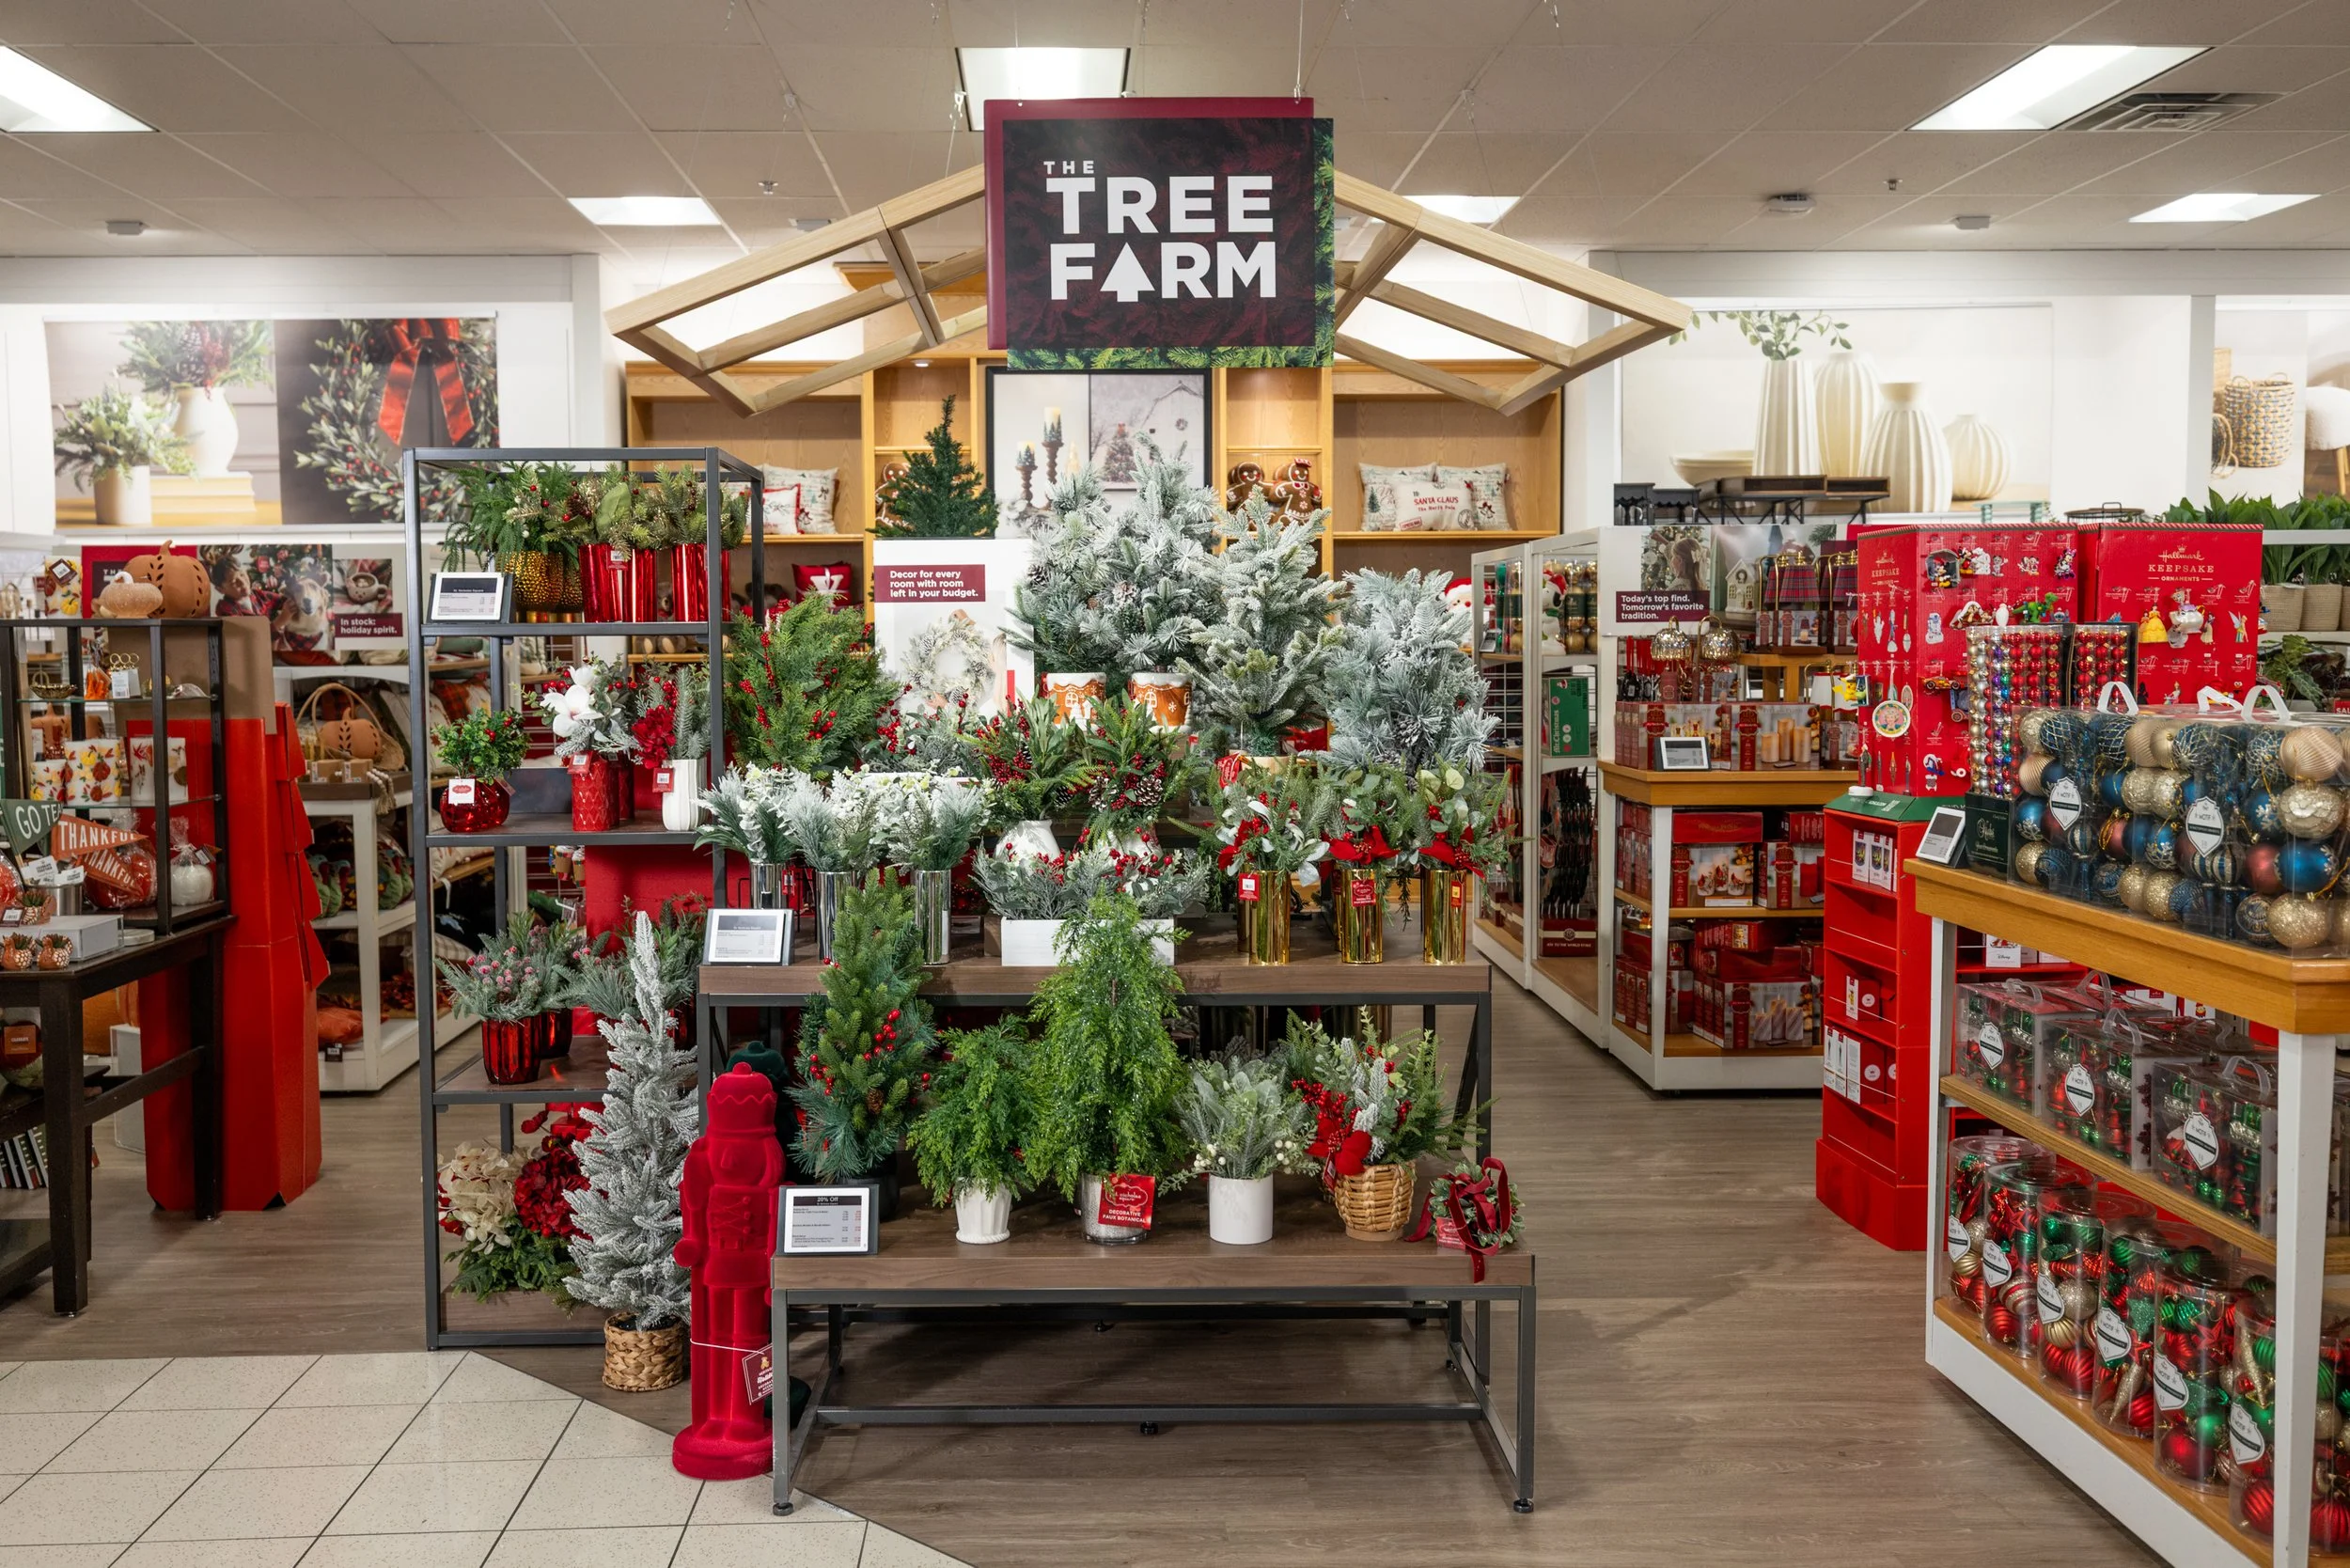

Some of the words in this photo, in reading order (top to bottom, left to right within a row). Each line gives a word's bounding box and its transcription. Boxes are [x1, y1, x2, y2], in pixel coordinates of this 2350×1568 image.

[1043, 161, 1095, 175] THE
[1045, 176, 1274, 235] TREE
[1050, 241, 1277, 303] FARM
[1414, 496, 1435, 505] SANTA
[2158, 549, 2205, 564] Hallmark
[2148, 564, 2215, 573] KEEPSAKE
[889, 571, 916, 579] Decor
[919, 570, 933, 579] for
[935, 570, 961, 580] every
[889, 580, 916, 588] room
[916, 579, 937, 588] with
[889, 588, 906, 598] left
[908, 588, 917, 598] in
[919, 589, 941, 599] your
[942, 588, 979, 599] budget.
[1621, 594, 1653, 604] Today's
[1654, 594, 1669, 604] top
[1670, 593, 1691, 603] find.
[1621, 603, 1670, 611] Tomorrow's
[1671, 603, 1705, 611] favorite
[1621, 612, 1660, 620] tradition.
[340, 618, 350, 626] In
[351, 618, 376, 626] stock:
[340, 626, 372, 635] holiday
[373, 625, 398, 635] spirit.
[15, 805, 41, 839] GO
[58, 820, 138, 851] THANKFUL
[1108, 1209, 1141, 1217] DECORATIVE
